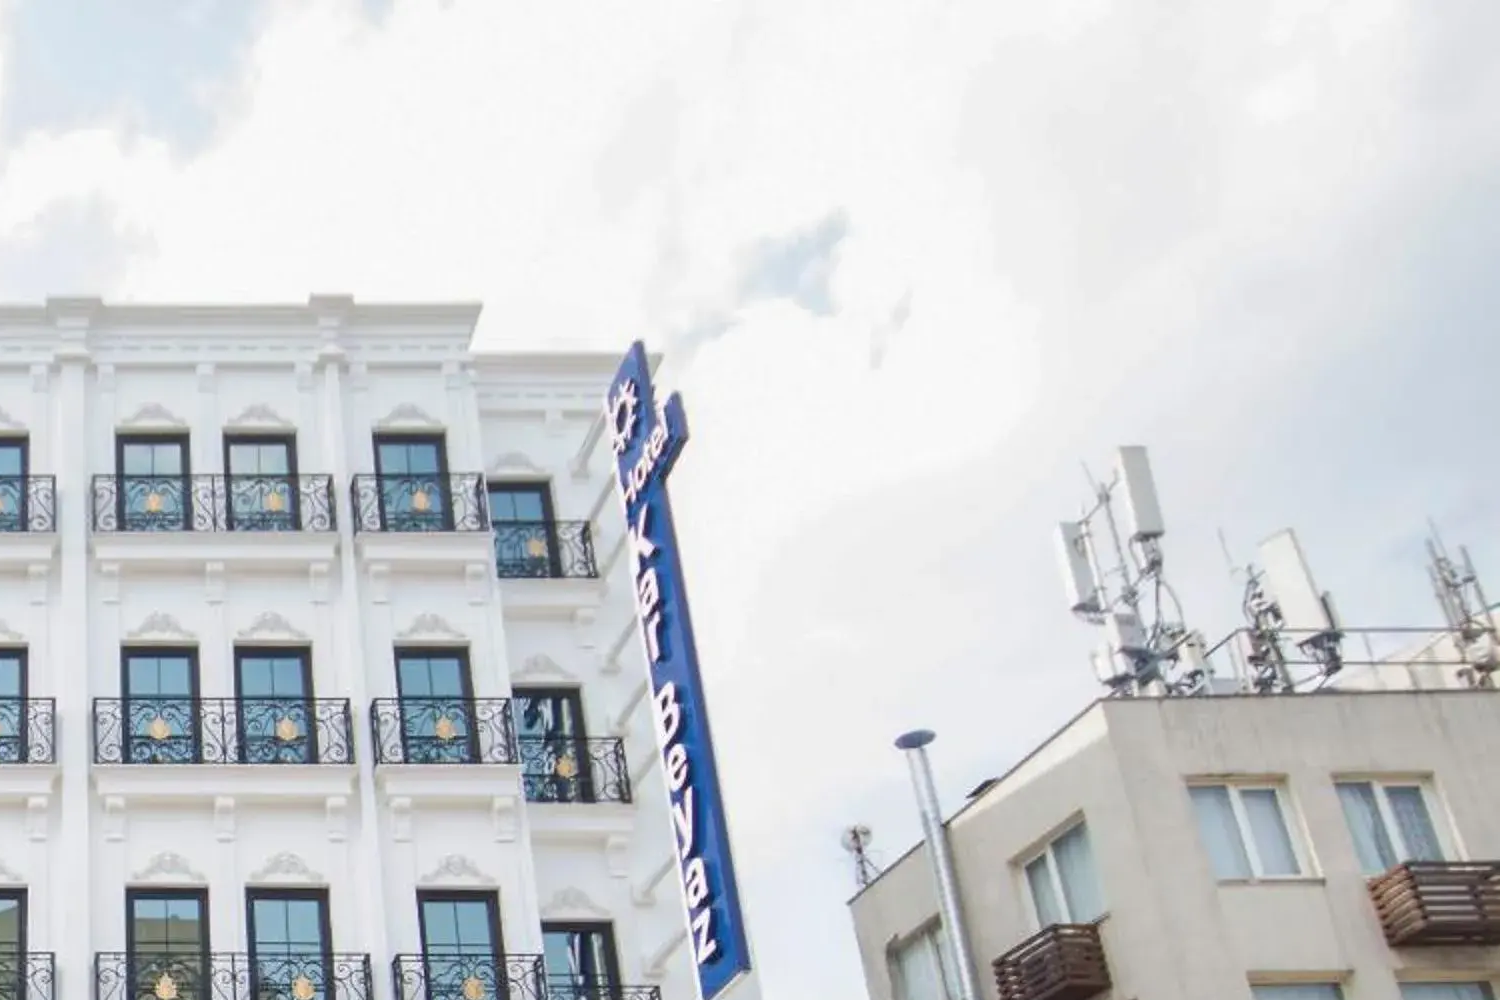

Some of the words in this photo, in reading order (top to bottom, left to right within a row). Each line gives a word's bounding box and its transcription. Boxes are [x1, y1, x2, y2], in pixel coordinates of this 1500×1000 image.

[622, 398, 668, 502] Hotel
[629, 503, 660, 662] Kar
[654, 681, 716, 965] Beyaz
